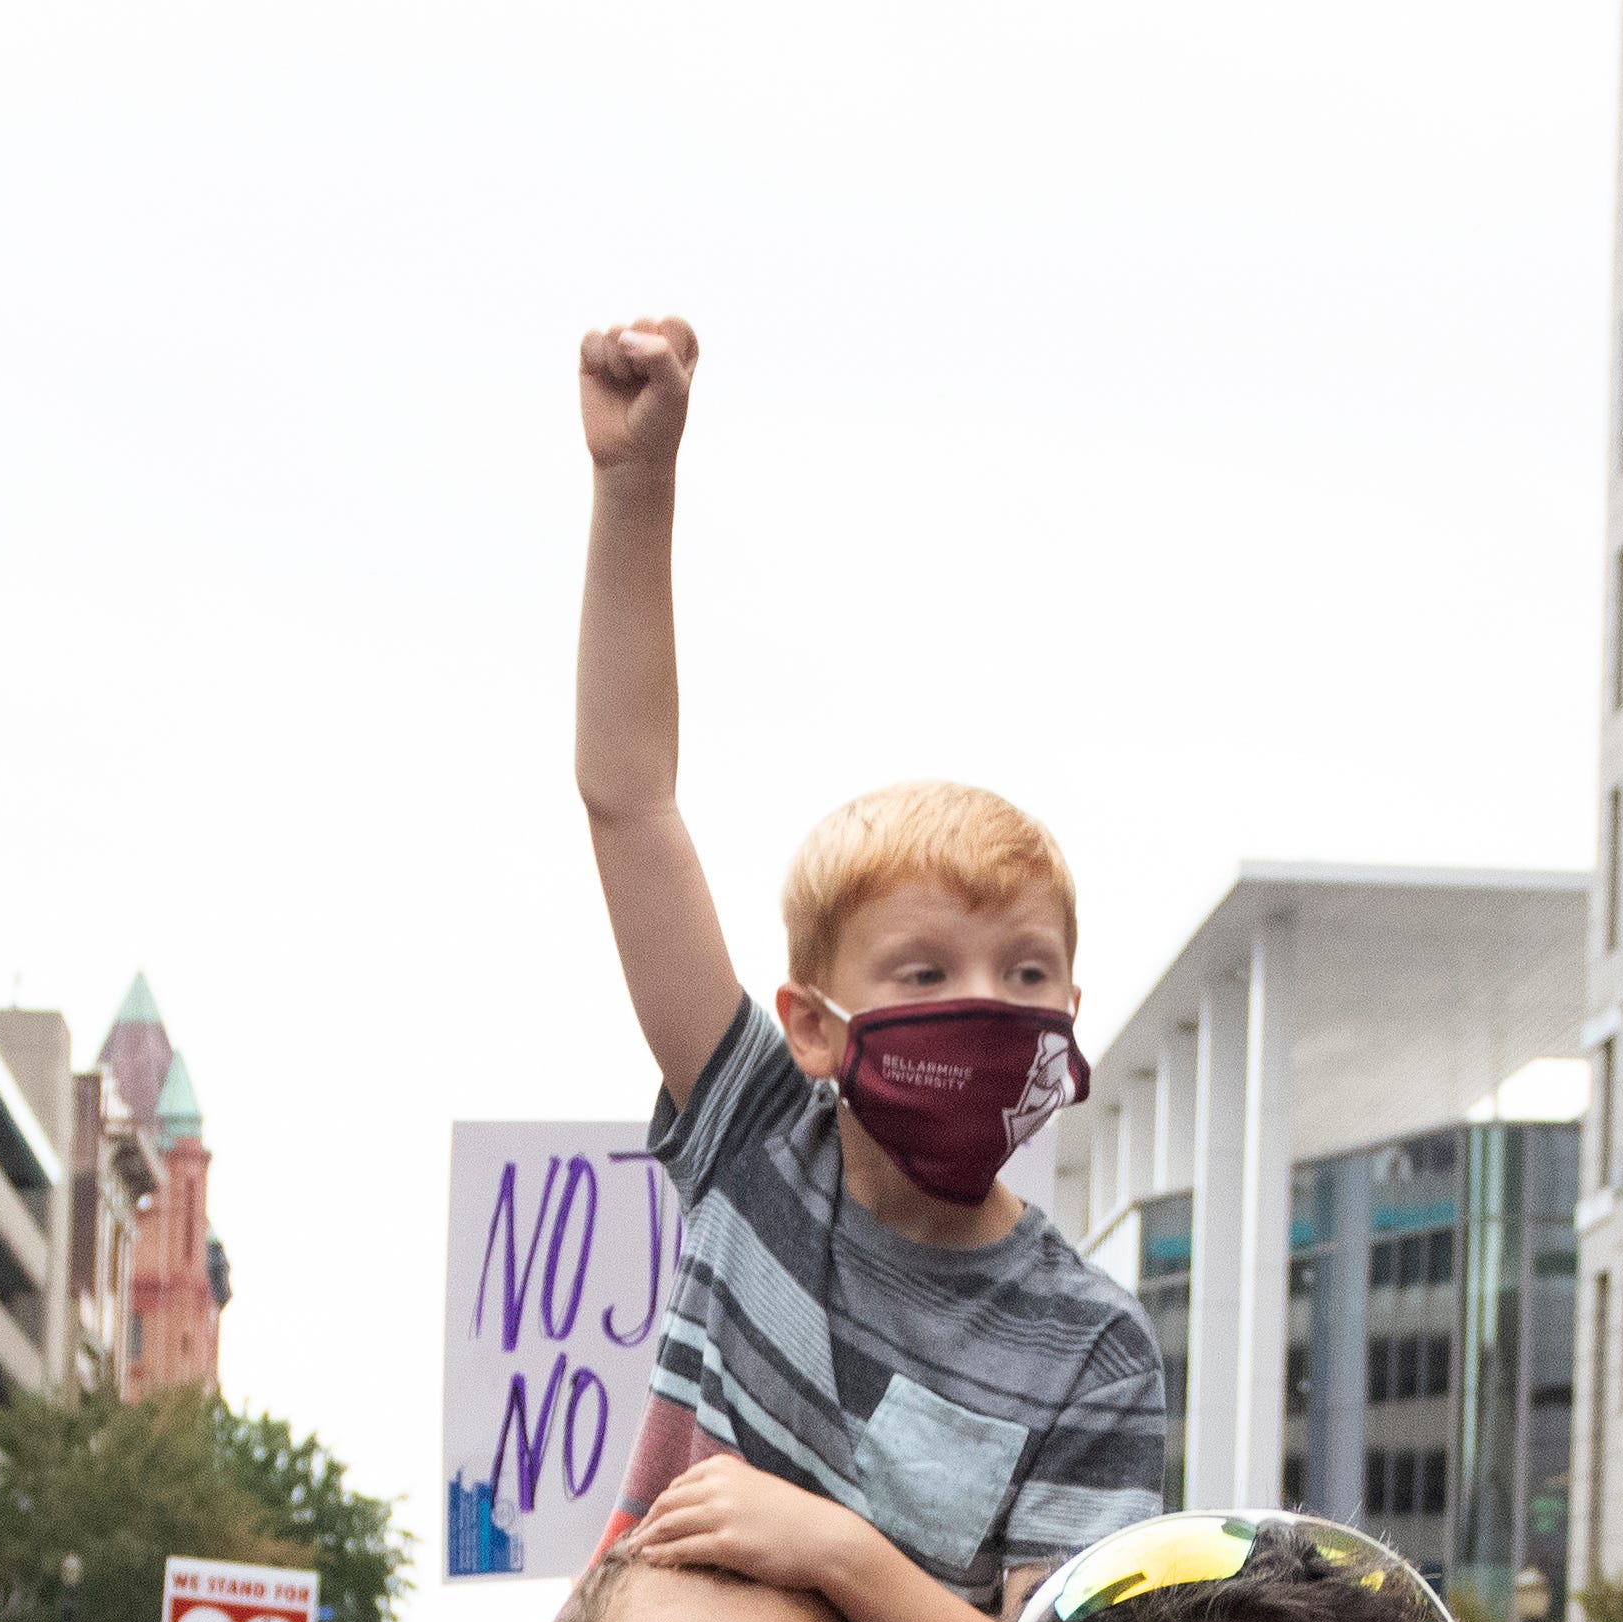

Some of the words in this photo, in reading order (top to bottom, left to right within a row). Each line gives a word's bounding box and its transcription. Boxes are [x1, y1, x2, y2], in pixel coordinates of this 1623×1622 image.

[881, 1066, 966, 1090] UNIVERSITY
[882, 1053, 974, 1079] BELLARMINE
[475, 1152, 599, 1352] NO
[490, 1351, 608, 1513] NO
[208, 1574, 266, 1598] STAND
[274, 1583, 309, 1602] FOR
